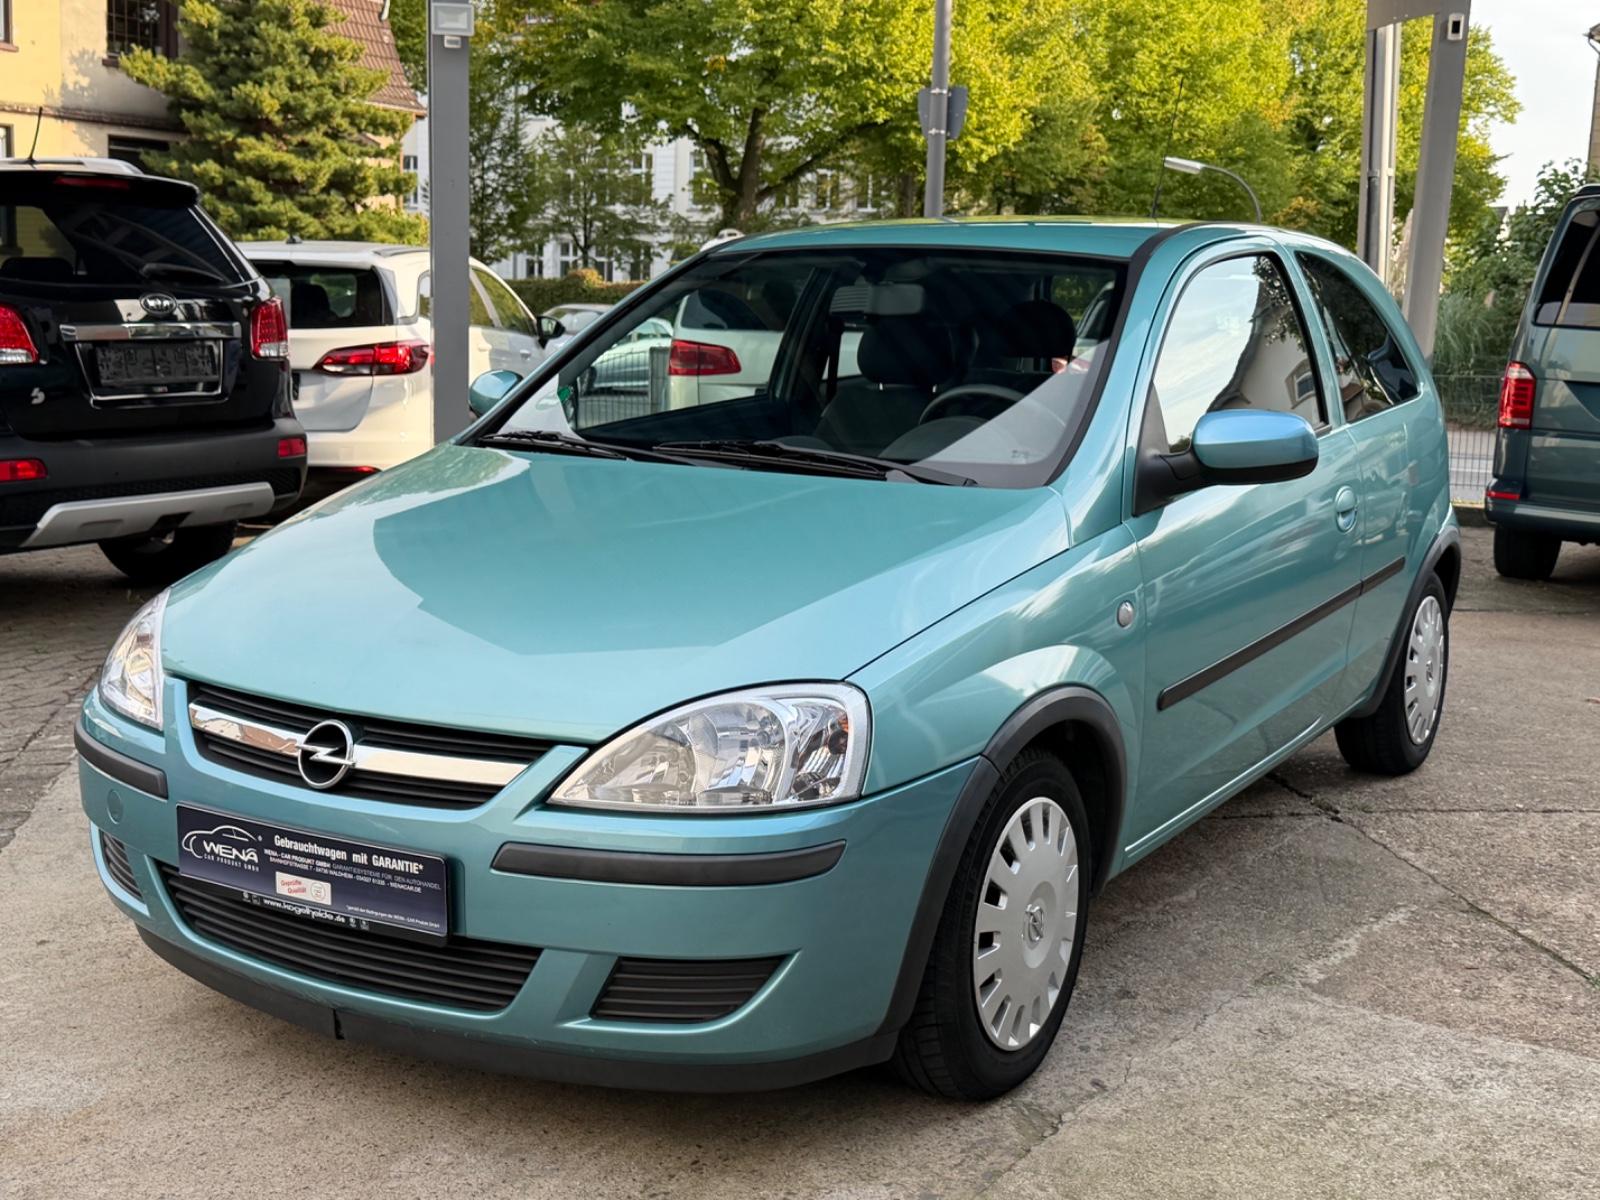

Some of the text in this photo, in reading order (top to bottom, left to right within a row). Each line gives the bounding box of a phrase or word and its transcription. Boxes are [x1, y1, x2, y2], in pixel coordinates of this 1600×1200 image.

[202, 840, 258, 863] WENA
[274, 834, 347, 861] Gebrauchtwagen
[352, 851, 367, 865] mit
